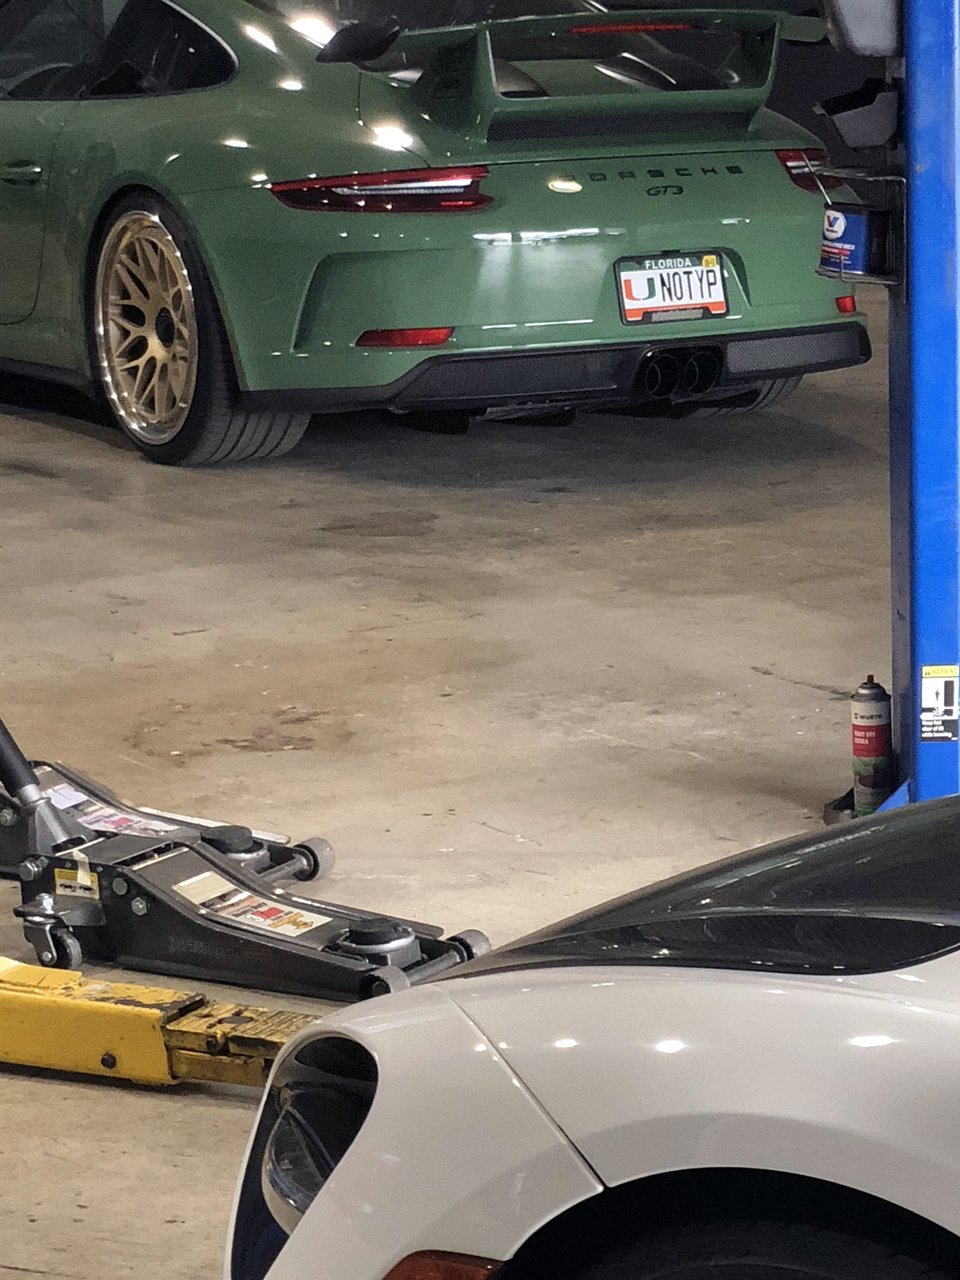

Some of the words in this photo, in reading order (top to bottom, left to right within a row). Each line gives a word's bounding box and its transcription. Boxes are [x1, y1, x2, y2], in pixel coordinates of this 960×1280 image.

[646, 185, 684, 197] GT3
[645, 257, 692, 270] FLORIDA
[659, 269, 718, 302] NOTYP
